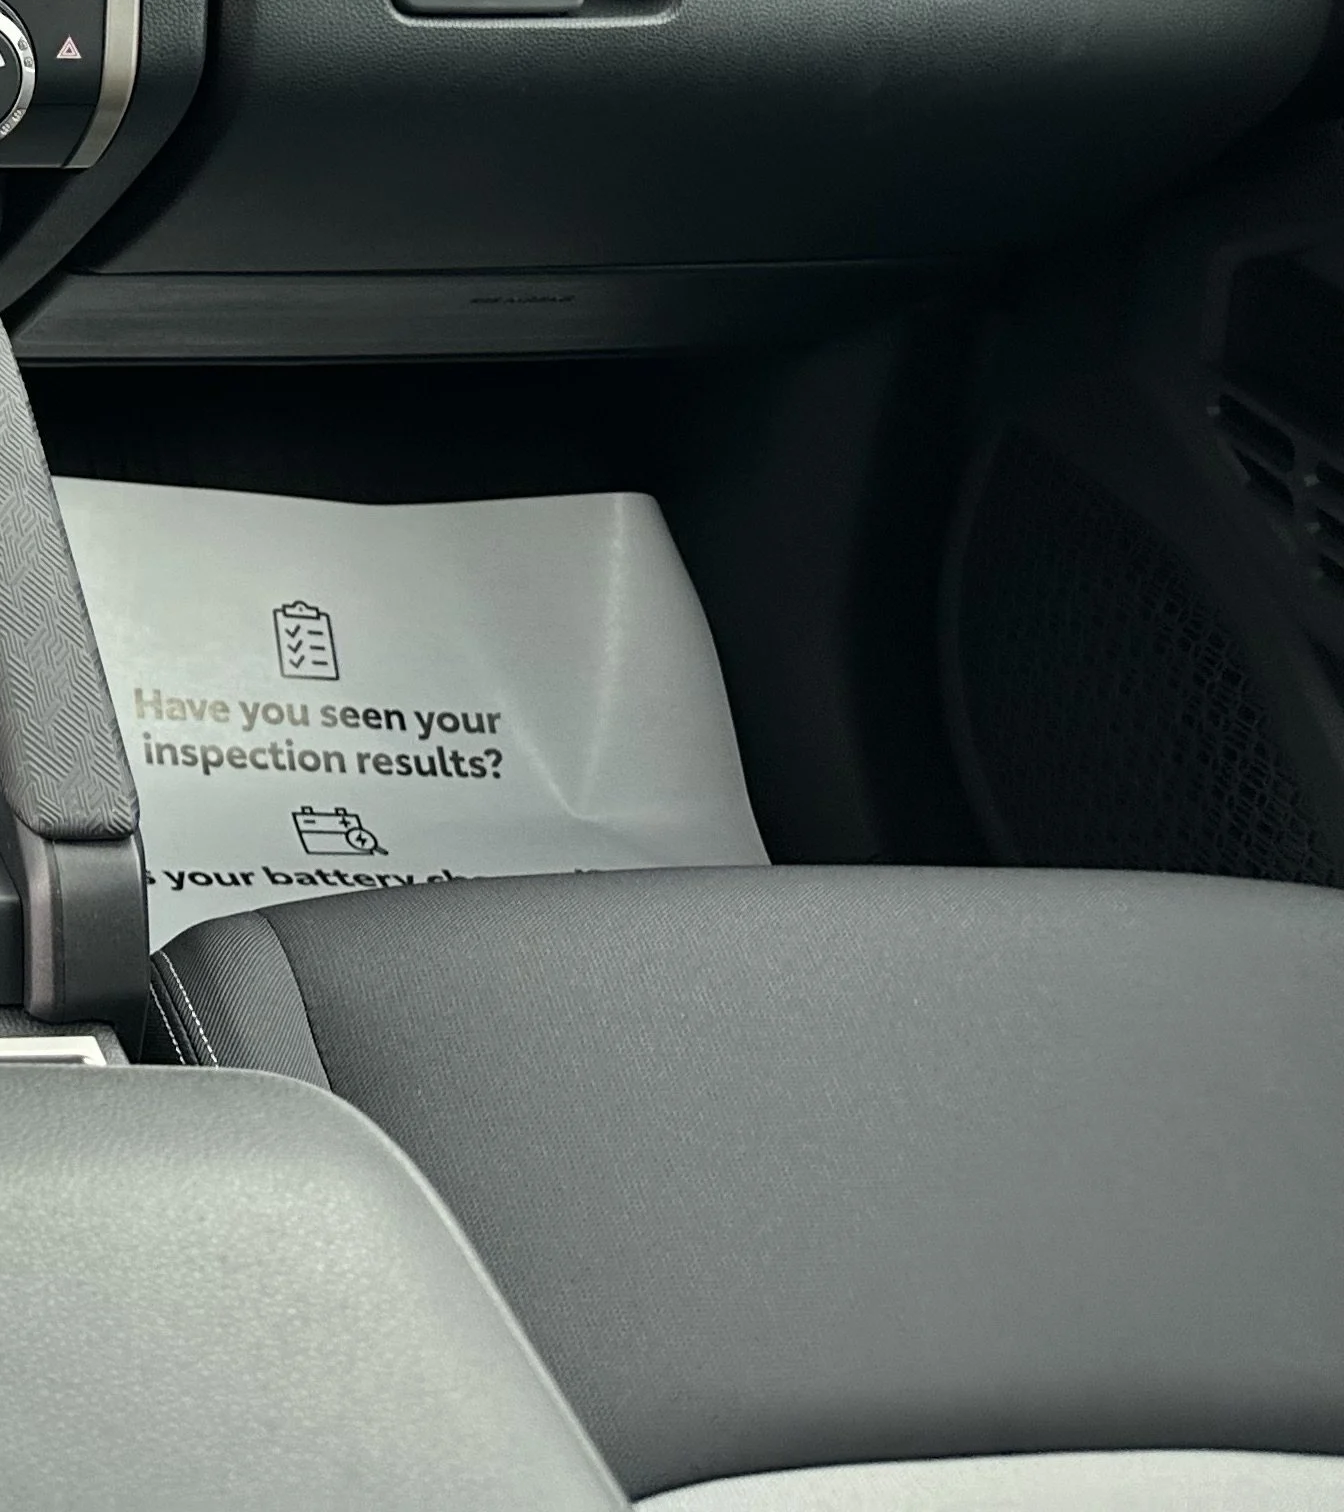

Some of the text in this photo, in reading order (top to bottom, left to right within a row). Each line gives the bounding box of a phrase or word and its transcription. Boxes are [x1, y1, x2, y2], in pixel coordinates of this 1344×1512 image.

[131, 687, 503, 741] Have you seen your
[142, 732, 505, 781] inspection results?
[163, 868, 256, 891] your
[261, 865, 415, 888] battery
